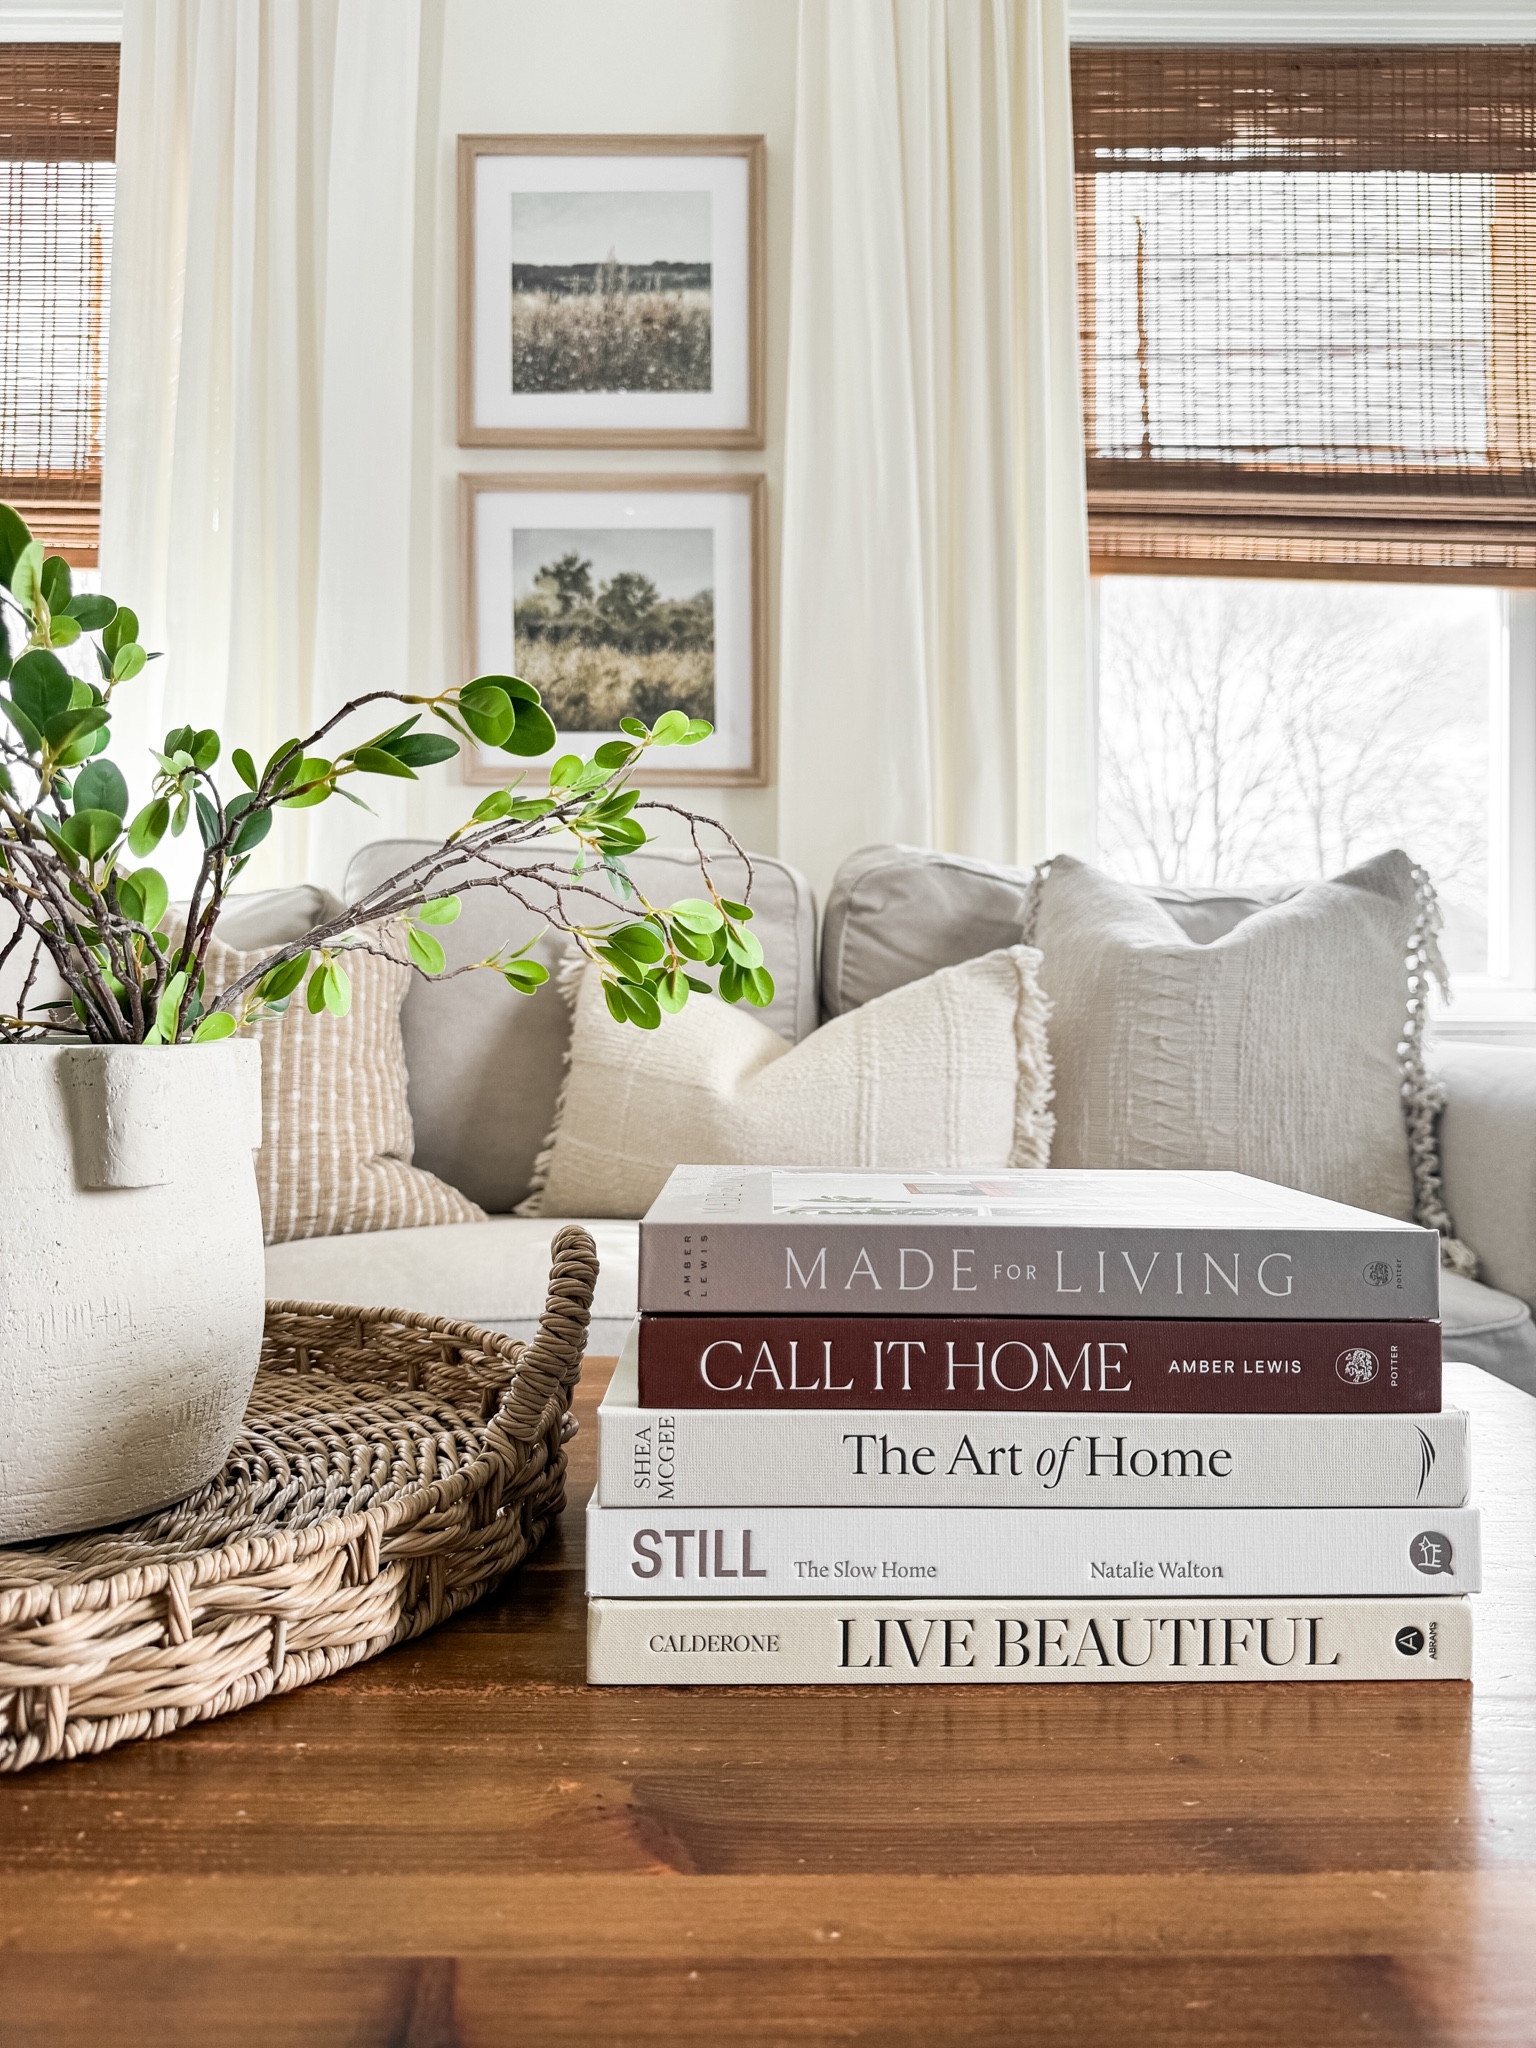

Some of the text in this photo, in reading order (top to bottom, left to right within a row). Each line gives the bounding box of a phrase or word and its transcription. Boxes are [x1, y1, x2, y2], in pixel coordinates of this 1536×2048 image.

[784, 1247, 1294, 1297] MADE FOR LIVING
[700, 1340, 1132, 1392] CALL IT HOME
[1168, 1359, 1302, 1374] AMBER LEWIS
[1390, 1345, 1399, 1387] POTTER
[633, 1426, 652, 1489] SHEA
[657, 1416, 676, 1500] MCGEE
[843, 1433, 1233, 1489] The Art of Home
[631, 1528, 767, 1579] STILL
[793, 1560, 937, 1579] The Slow Home
[1089, 1561, 1224, 1579] Natalie Walton
[649, 1634, 780, 1653] CALDERONE
[836, 1617, 1341, 1668] LIVE BEAUTIFUL
[1429, 1621, 1437, 1660] ABRAMS
